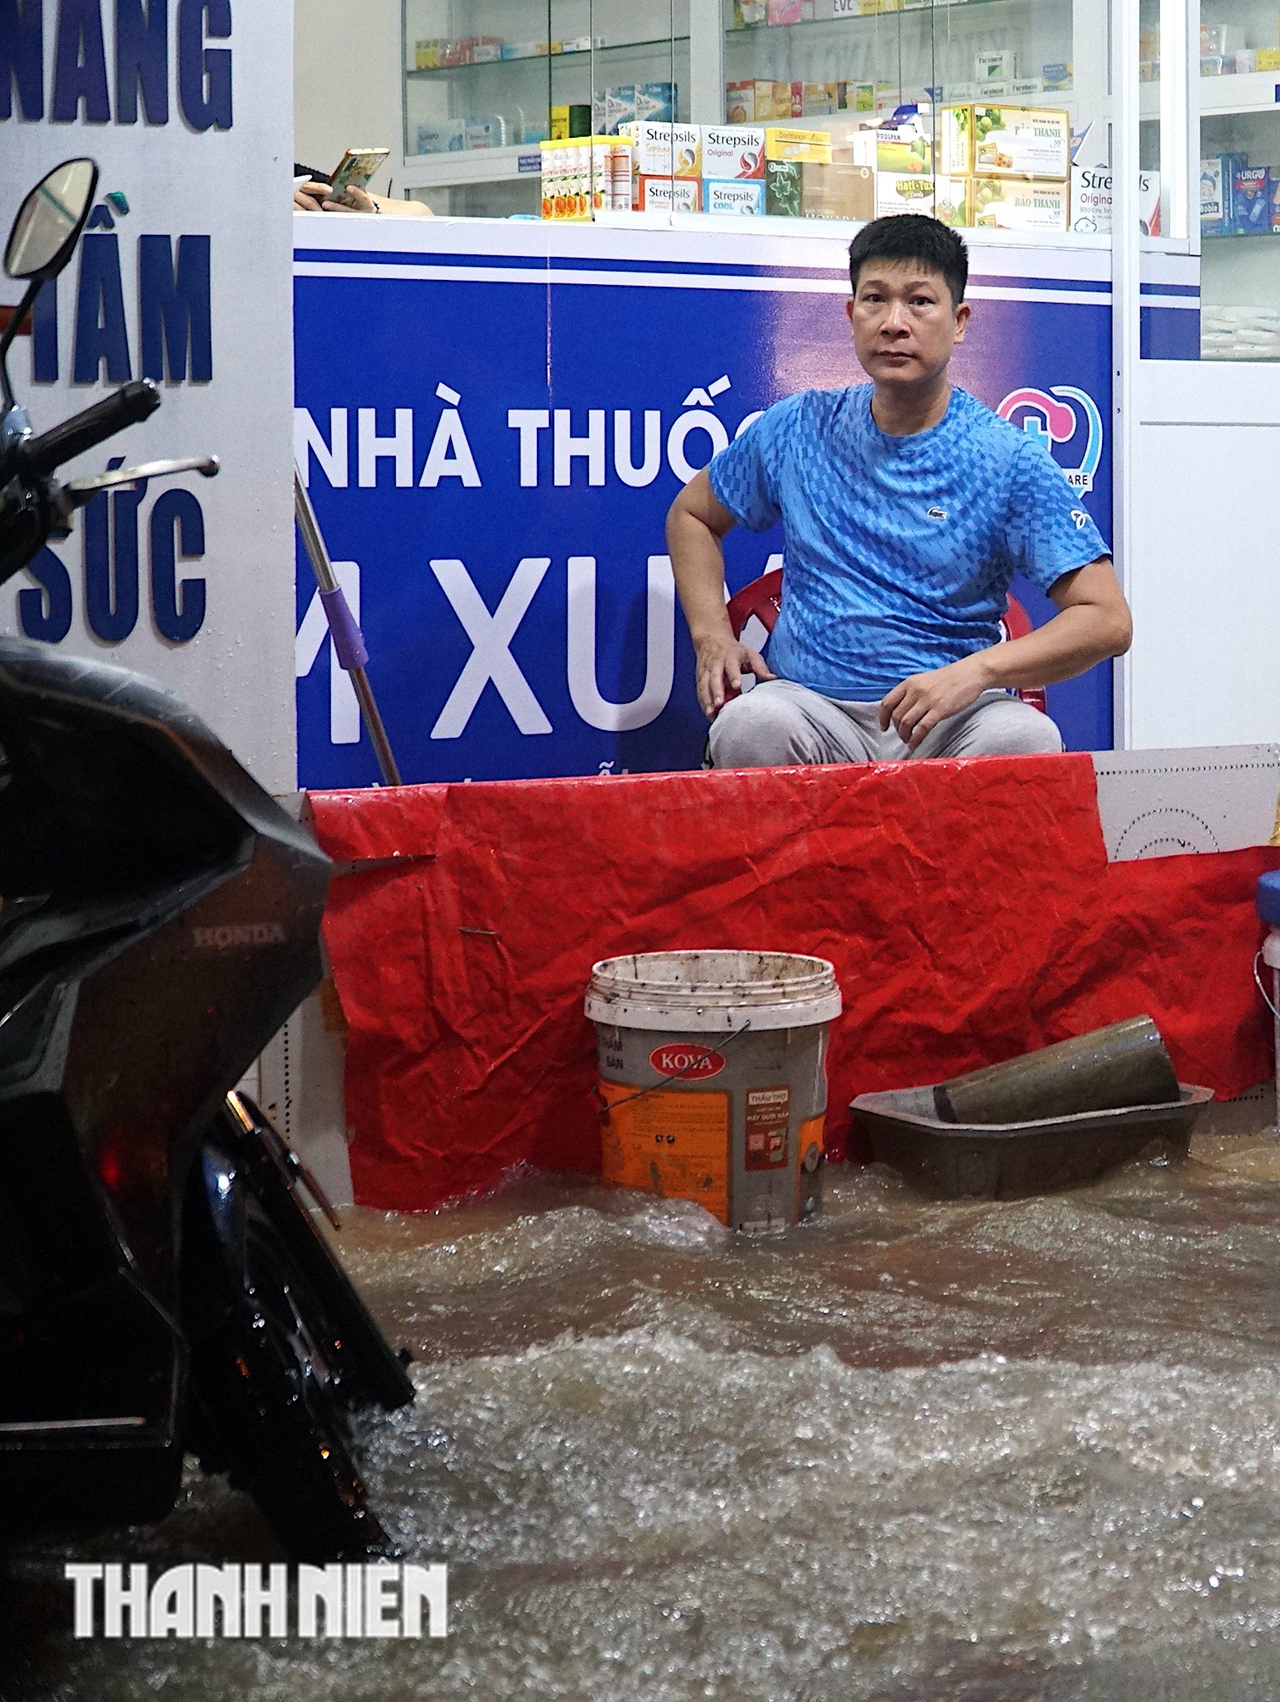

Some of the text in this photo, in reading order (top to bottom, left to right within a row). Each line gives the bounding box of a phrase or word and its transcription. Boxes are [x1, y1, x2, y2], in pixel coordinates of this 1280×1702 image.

[646, 128, 696, 144] Strepsils
[708, 132, 760, 148] Strepsils
[707, 149, 734, 158] Original
[649, 187, 691, 200] Strepsils
[713, 190, 754, 203] Strepsils
[1080, 193, 1113, 207] Origina
[294, 374, 767, 488] NHÀ THUỐ
[1067, 474, 1089, 486] ARE
[661, 1053, 713, 1070] KOVA
